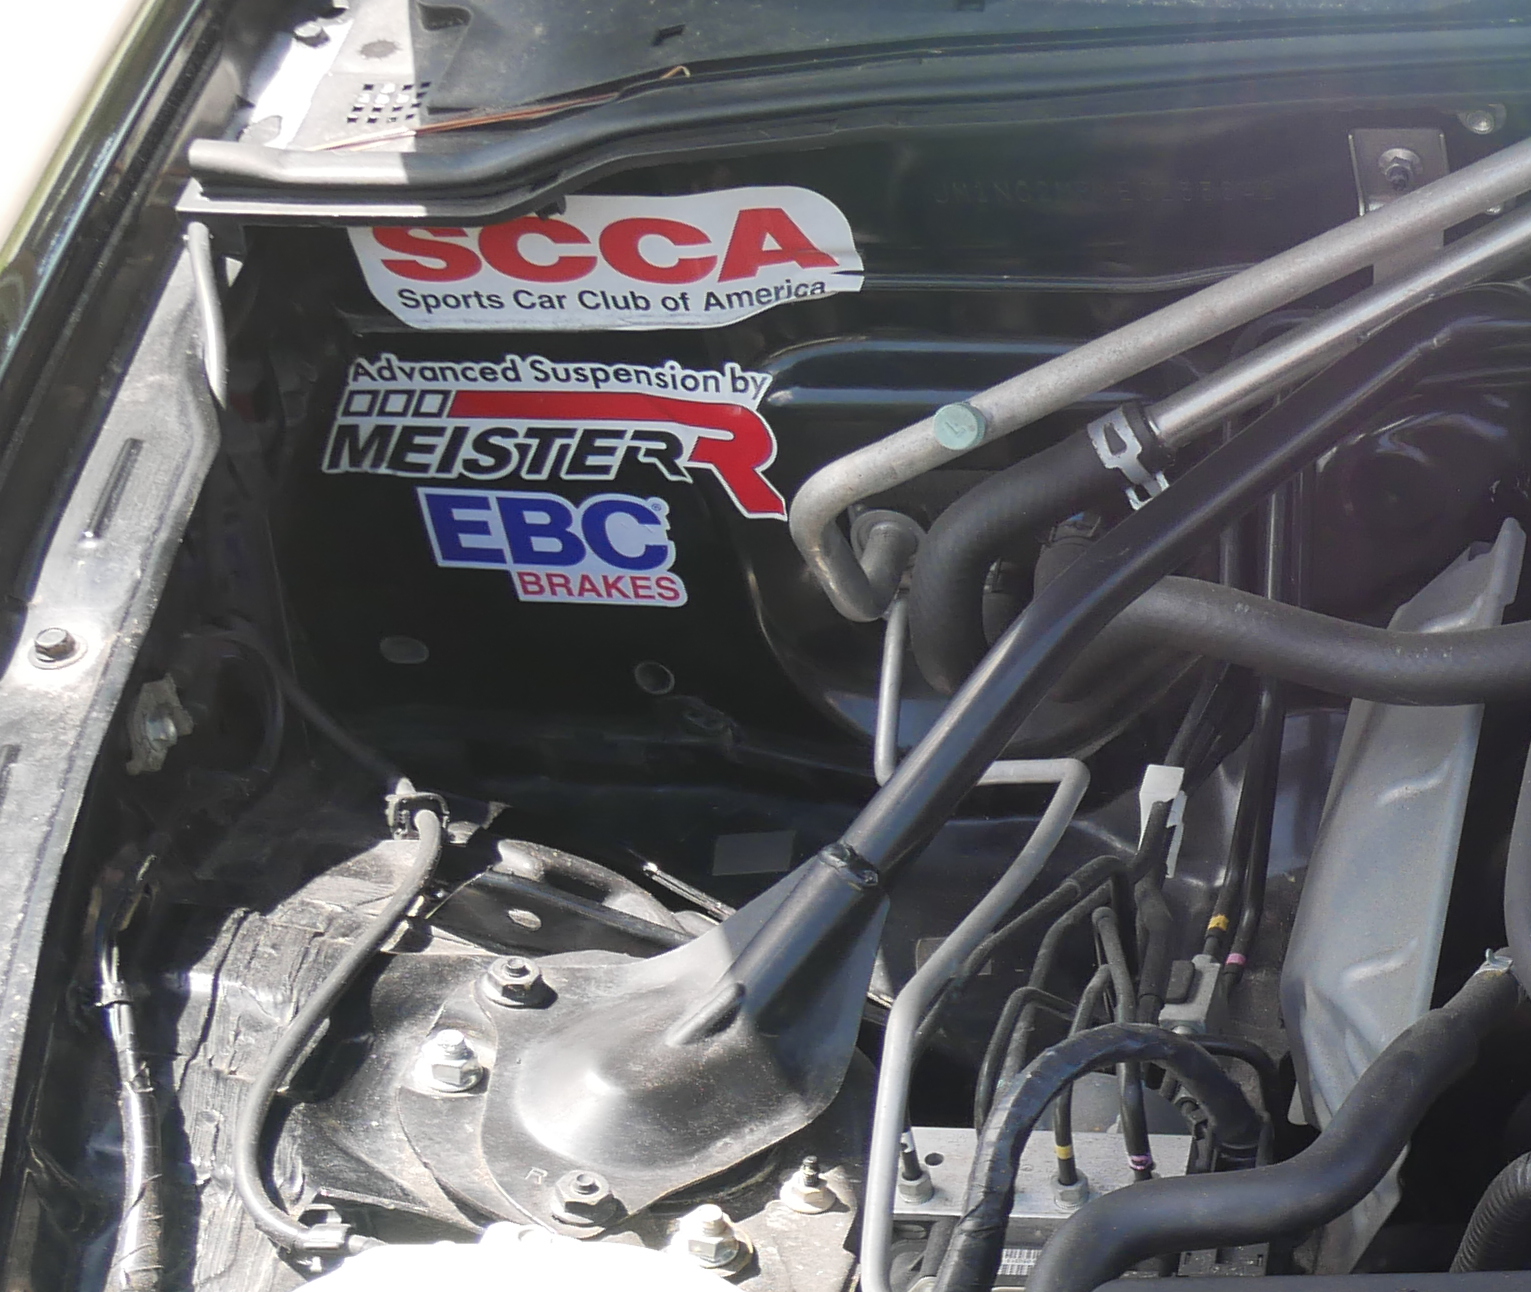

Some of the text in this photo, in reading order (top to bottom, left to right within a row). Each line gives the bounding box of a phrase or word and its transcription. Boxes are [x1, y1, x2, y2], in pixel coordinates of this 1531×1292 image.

[372, 206, 840, 285] SCCA
[399, 278, 826, 313] Sports Car Club of America
[352, 355, 767, 401] Advanced Suspension by
[424, 494, 669, 571] EBC
[520, 571, 681, 601] BRAKES
